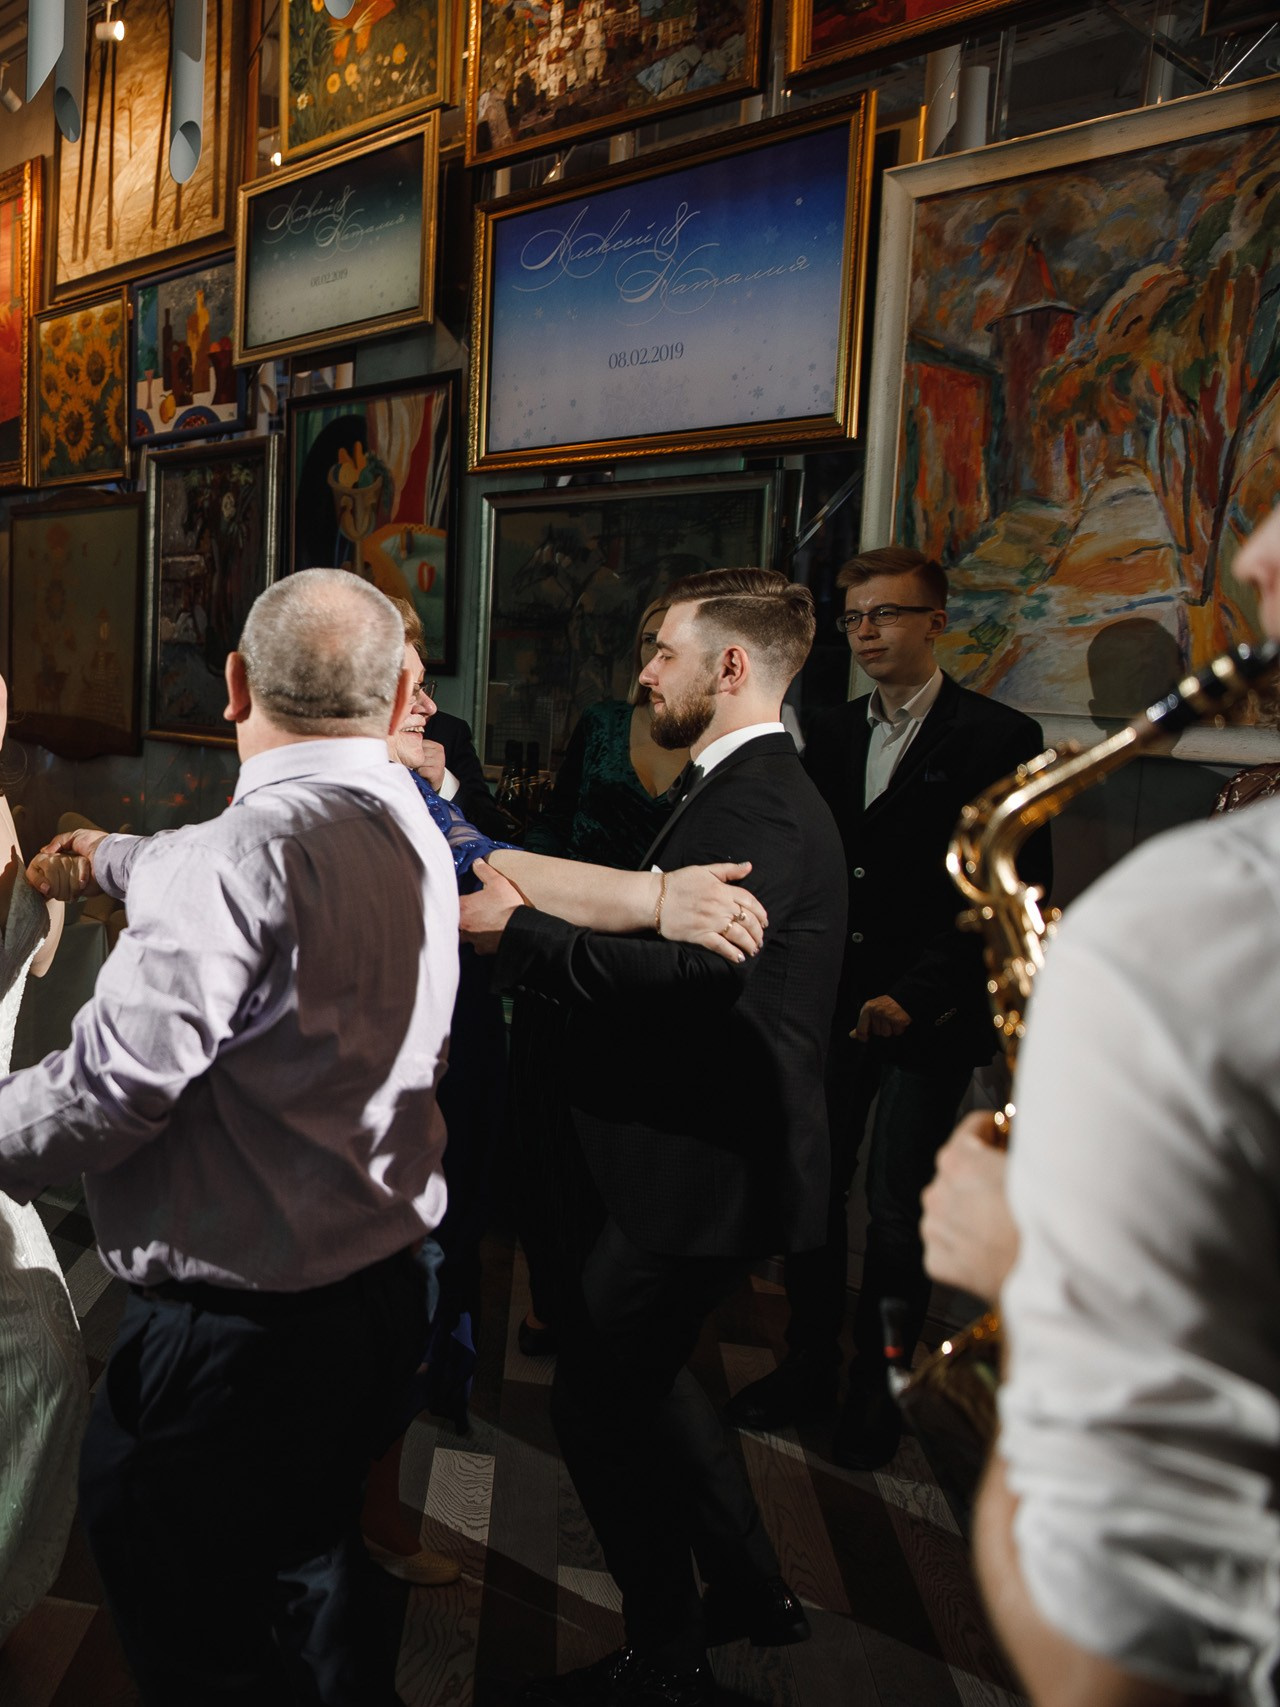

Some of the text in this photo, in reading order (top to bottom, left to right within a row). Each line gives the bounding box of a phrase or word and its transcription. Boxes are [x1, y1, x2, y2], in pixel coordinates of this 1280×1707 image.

[512, 201, 701, 292] Алексей &
[615, 243, 810, 326] Наталия
[608, 341, 685, 370] 08.02.2019
